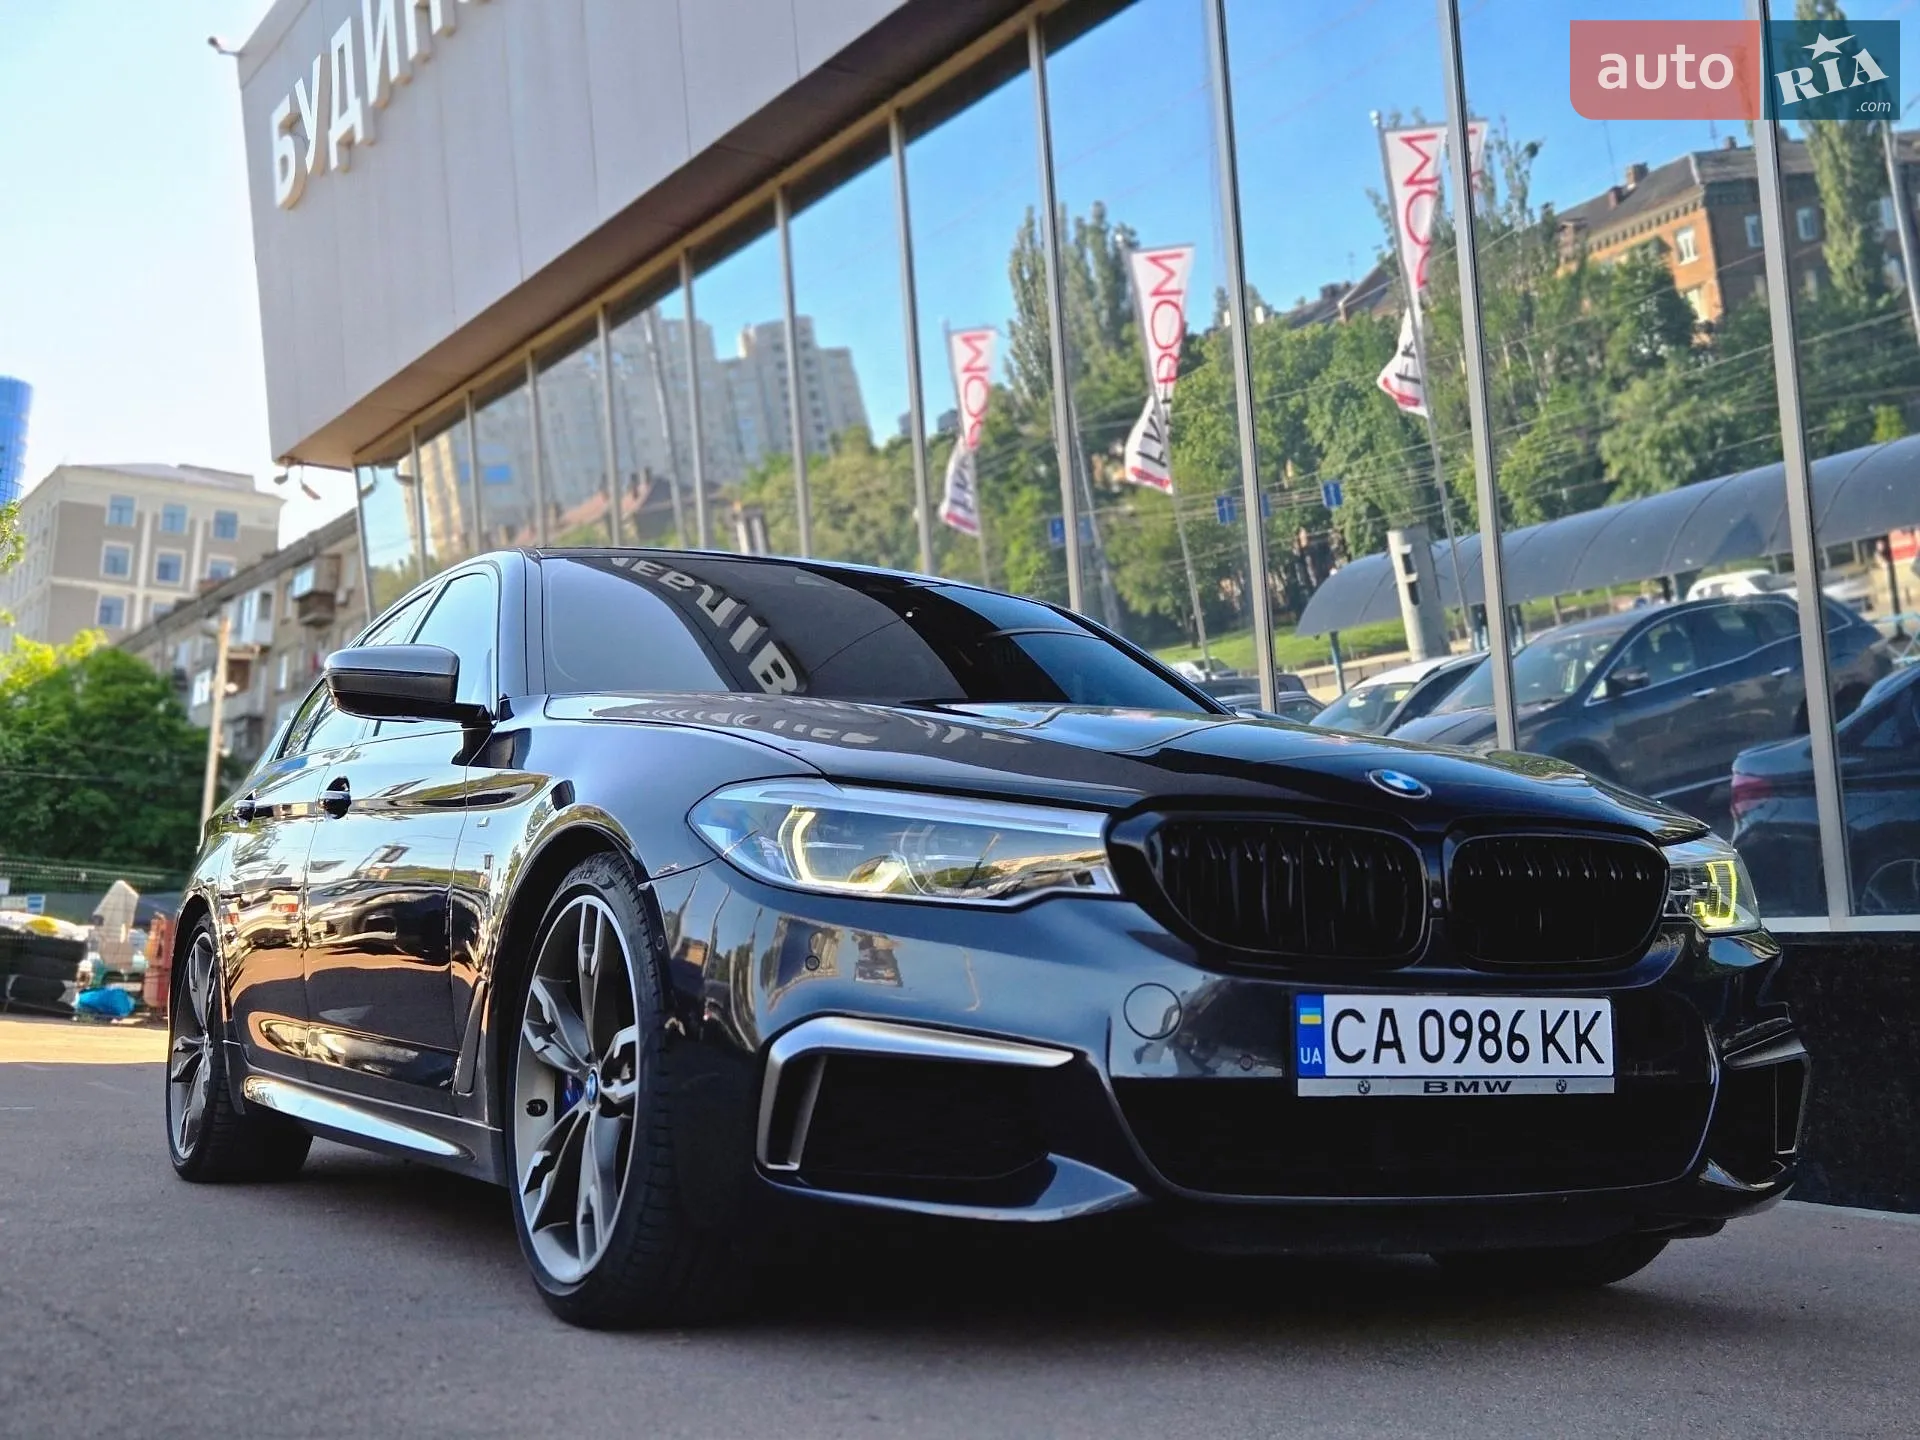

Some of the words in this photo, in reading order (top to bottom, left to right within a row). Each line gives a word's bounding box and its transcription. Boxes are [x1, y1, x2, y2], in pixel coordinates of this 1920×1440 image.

[271, 0, 470, 208] БУДИН
[1331, 1008, 1406, 1064] CA
[1418, 1009, 1531, 1064] 0986
[1540, 1009, 1605, 1064] KK
[1300, 1047, 1322, 1065] UA
[1423, 1080, 1512, 1094] BMW
